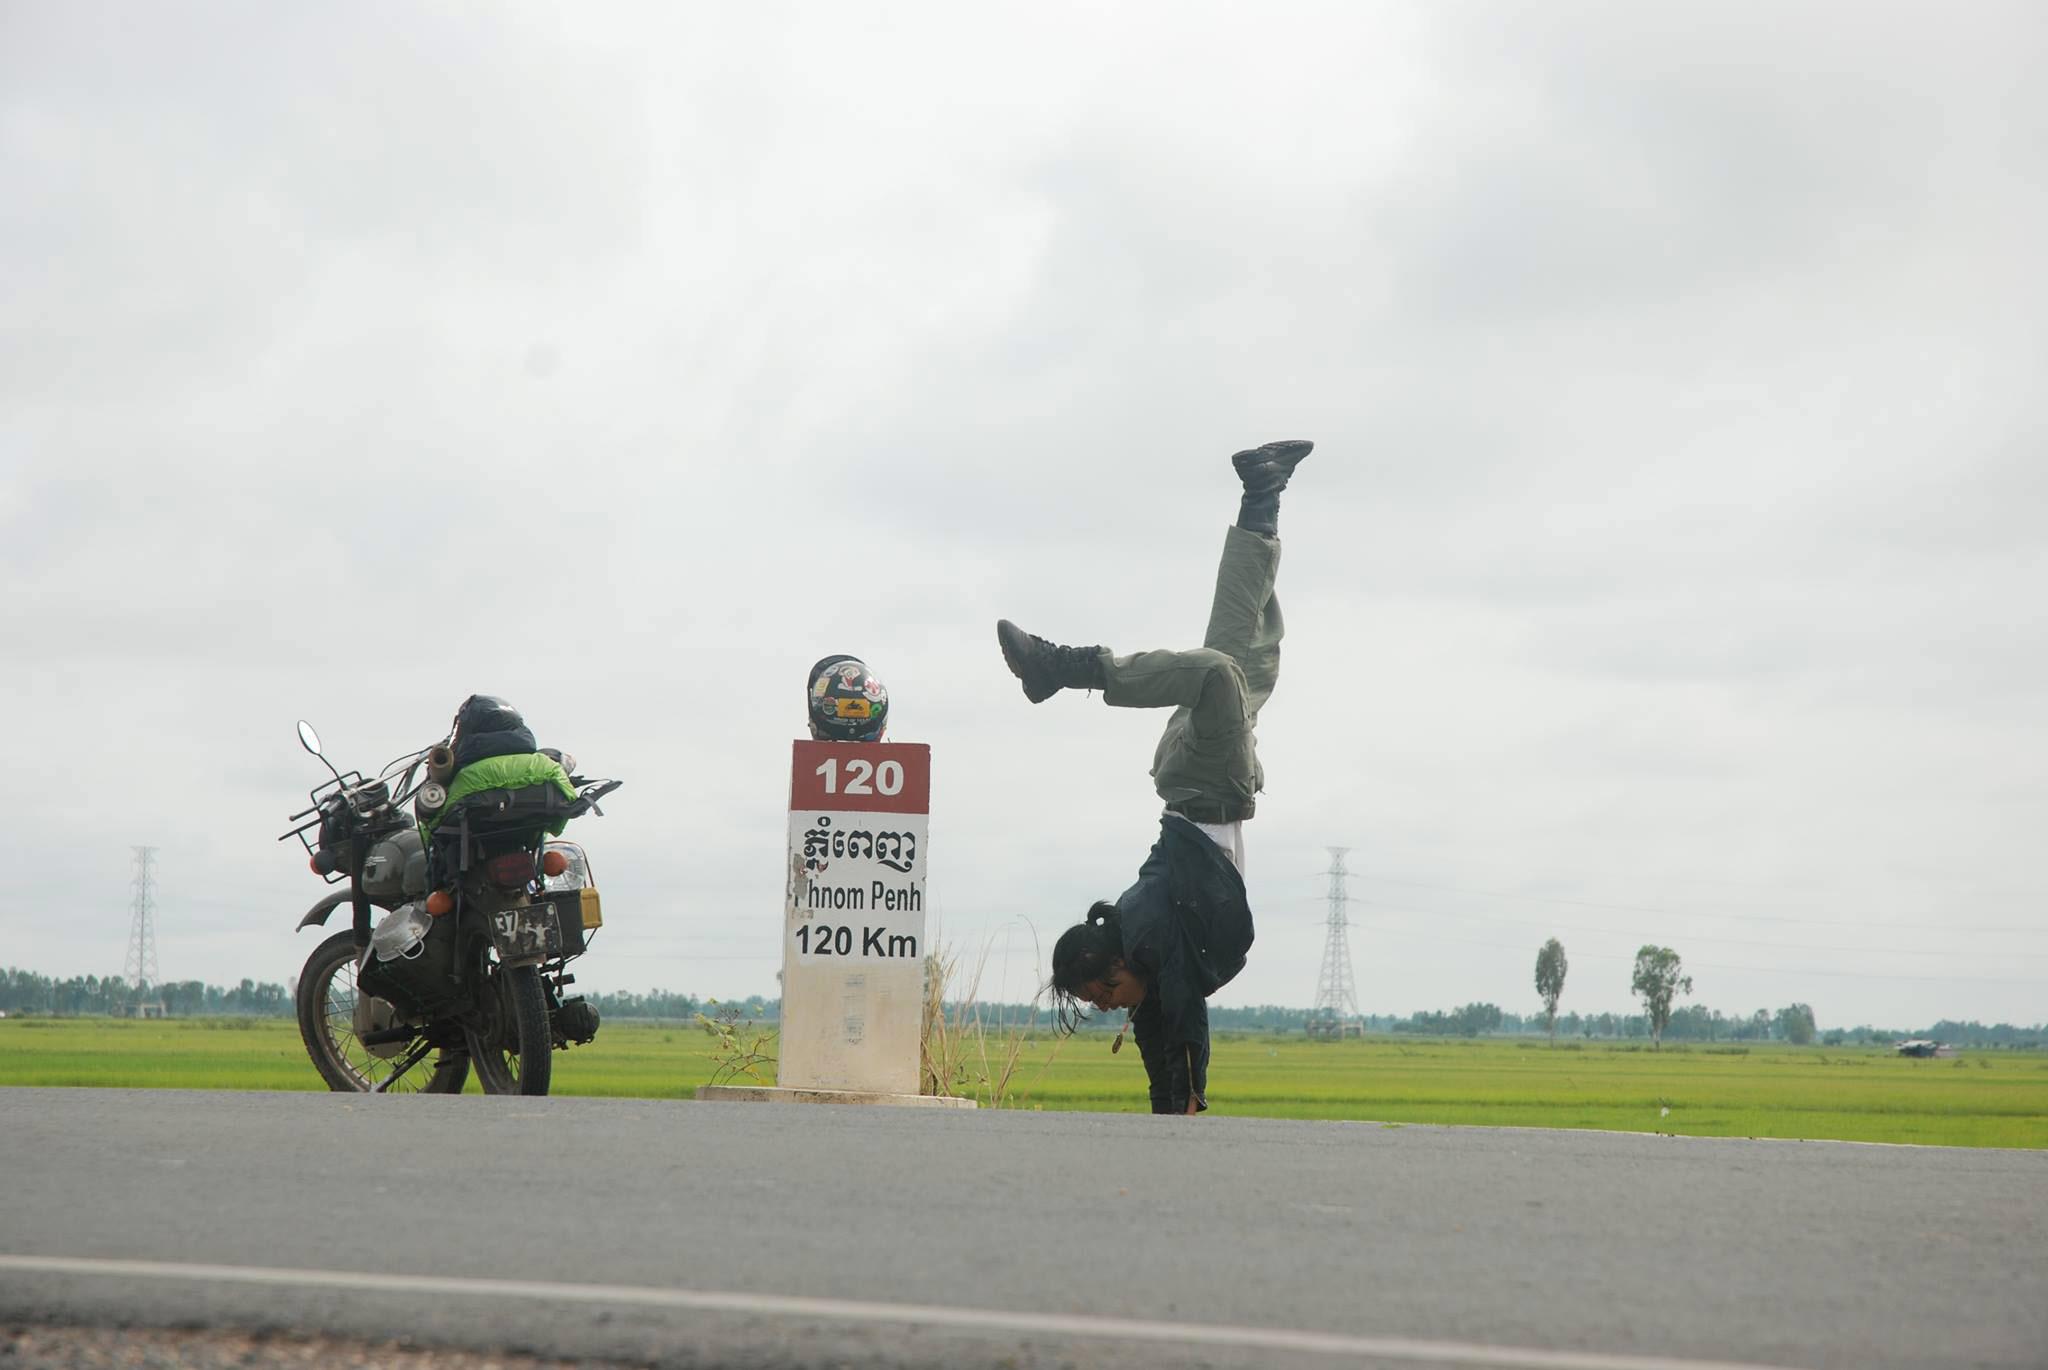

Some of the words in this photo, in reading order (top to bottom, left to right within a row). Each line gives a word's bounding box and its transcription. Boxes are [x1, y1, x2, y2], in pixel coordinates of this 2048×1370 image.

[815, 758, 905, 796] 120
[872, 880, 921, 912] Penh
[795, 925, 852, 956] 120
[863, 926, 917, 958] Km
